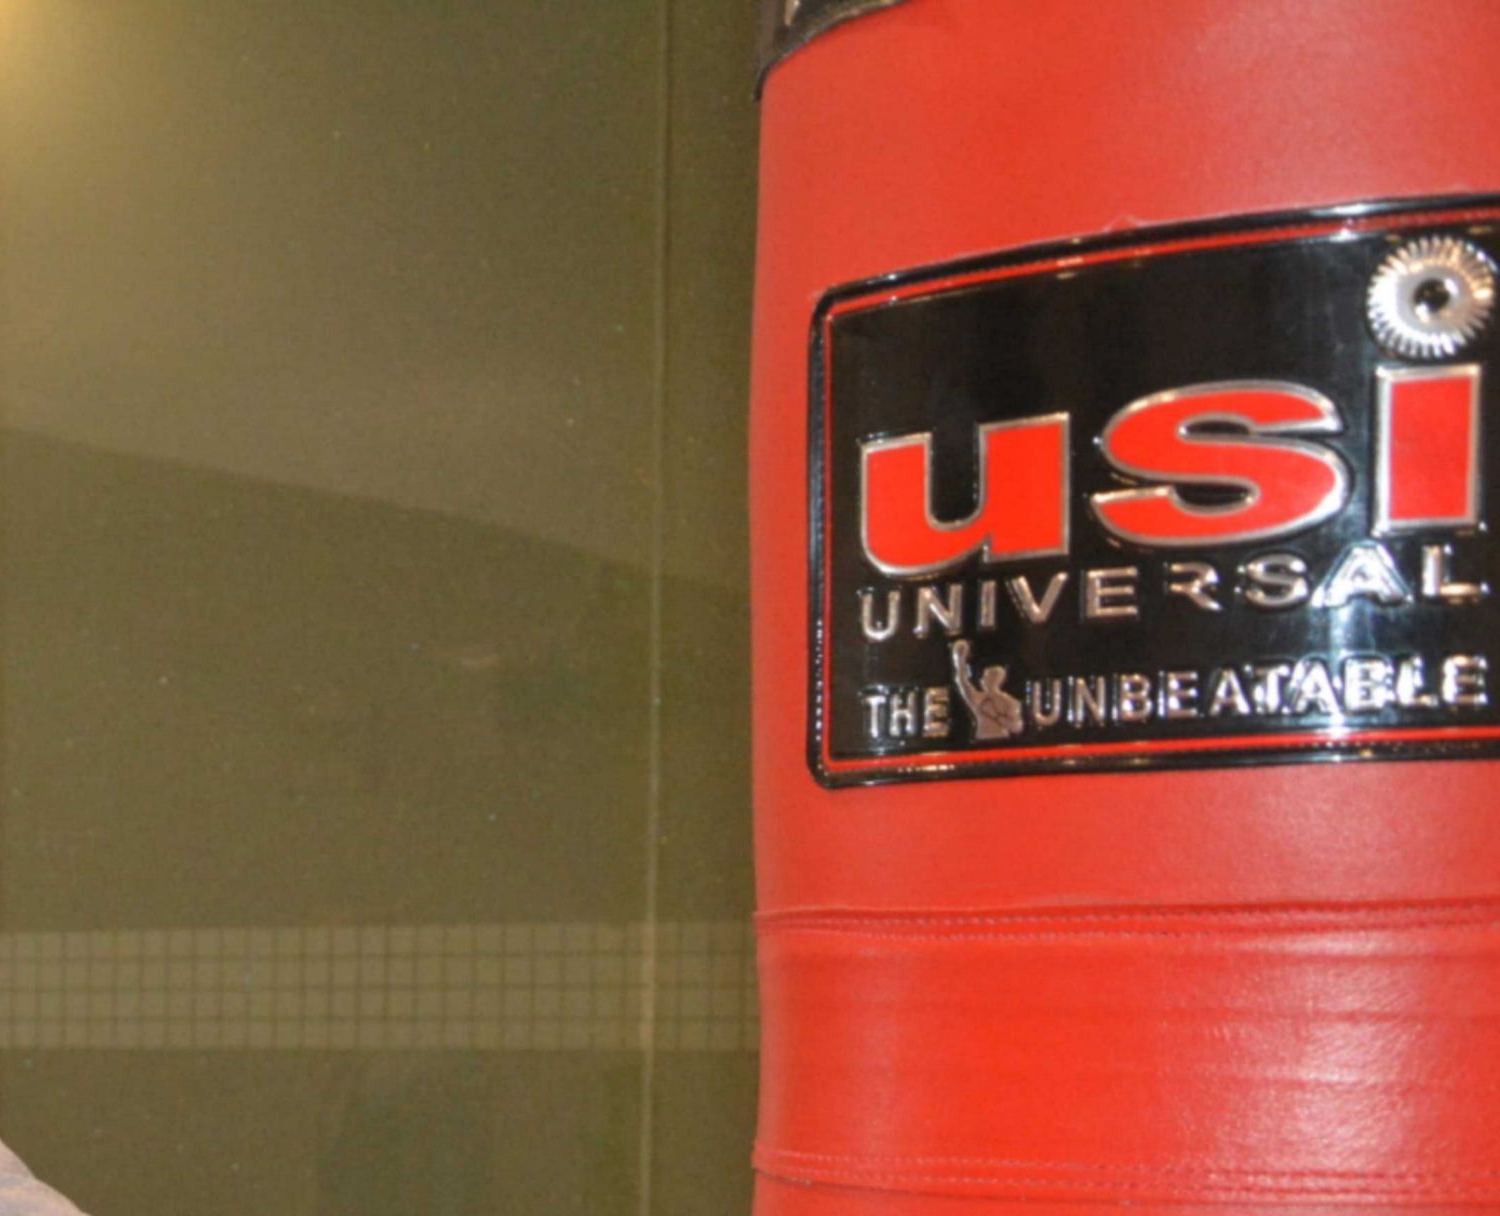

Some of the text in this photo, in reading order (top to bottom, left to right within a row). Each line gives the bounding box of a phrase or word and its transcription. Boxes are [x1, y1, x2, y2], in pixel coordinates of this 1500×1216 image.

[858, 234, 1495, 579] usi
[860, 544, 1489, 641] UNIVERSAL
[863, 655, 1487, 739] THE UNBEATABLE
